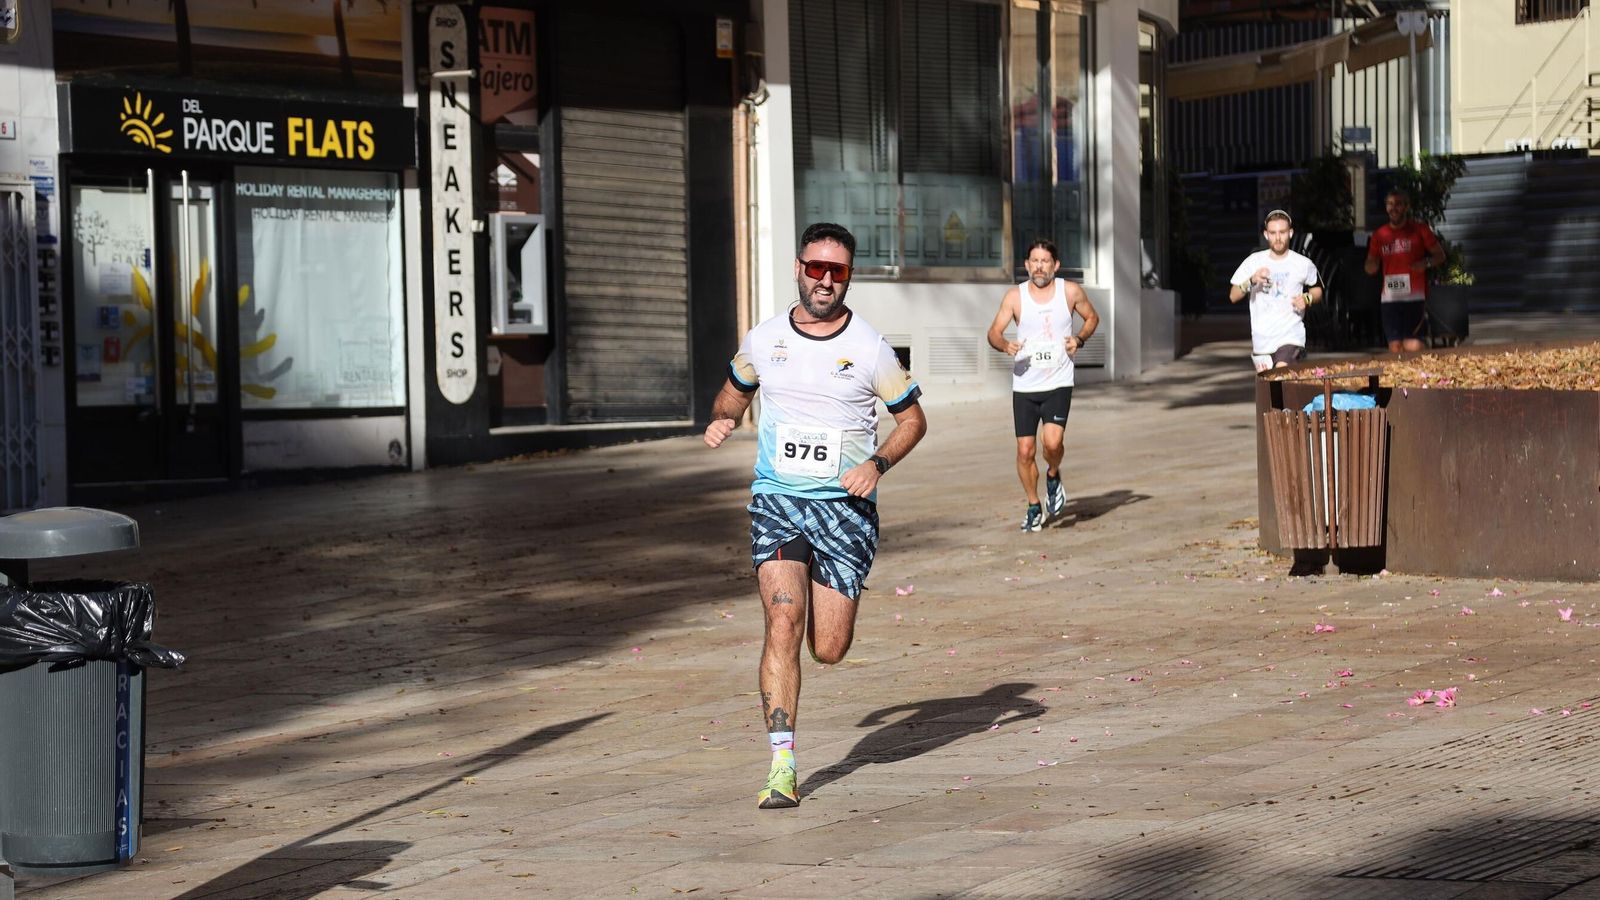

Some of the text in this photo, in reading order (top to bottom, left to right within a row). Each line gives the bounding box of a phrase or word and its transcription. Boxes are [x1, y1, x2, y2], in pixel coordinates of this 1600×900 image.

[435, 16, 458, 28] SHOP
[480, 18, 531, 56] ATM
[480, 62, 533, 96] ajero
[182, 99, 203, 113] DEL
[183, 116, 375, 160] PARQUE FLATS
[235, 182, 396, 201] HOLIDAY RENTAL MANAGEMENT
[440, 41, 465, 358] SNEAKERS
[1035, 351, 1051, 361] 36
[446, 368, 468, 379] SHOP
[784, 441, 828, 462] 976
[116, 658, 128, 836] RACIAS
